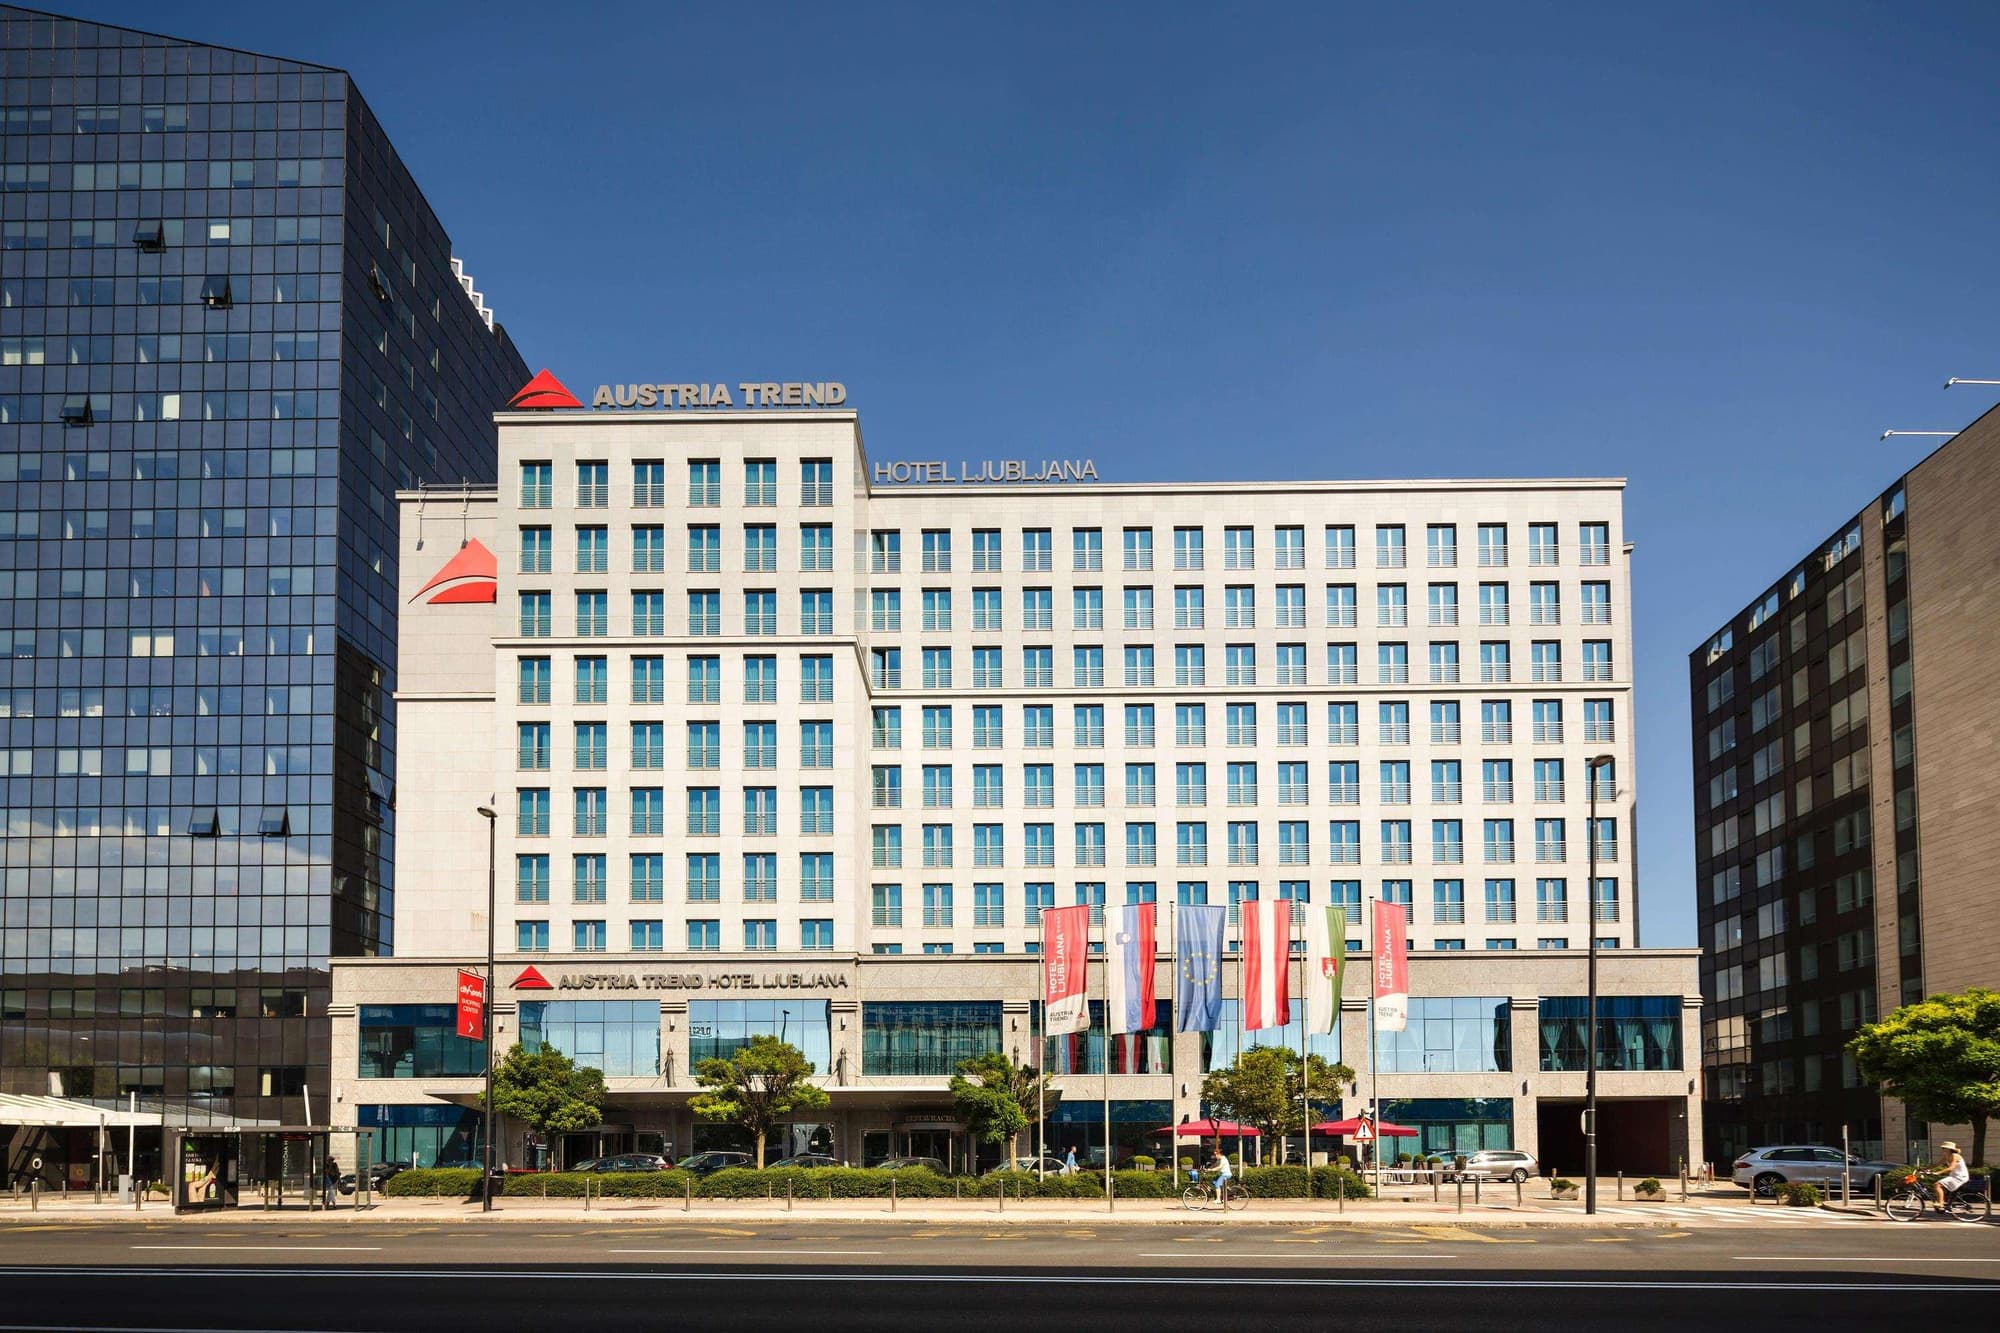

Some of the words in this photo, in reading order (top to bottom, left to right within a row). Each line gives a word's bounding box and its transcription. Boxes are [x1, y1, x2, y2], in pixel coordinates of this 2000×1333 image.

[593, 384, 733, 407] AUSTRIA
[740, 382, 846, 406] TREND
[874, 462, 956, 483] HOTEL
[961, 459, 1099, 482] LJUBLJANA
[1056, 933, 1065, 992] LJUBLJANA
[558, 974, 639, 990] AUSTRIA
[642, 974, 704, 990] TREND
[708, 974, 760, 989] HOTEL
[763, 973, 848, 989] LJUBLJANA
